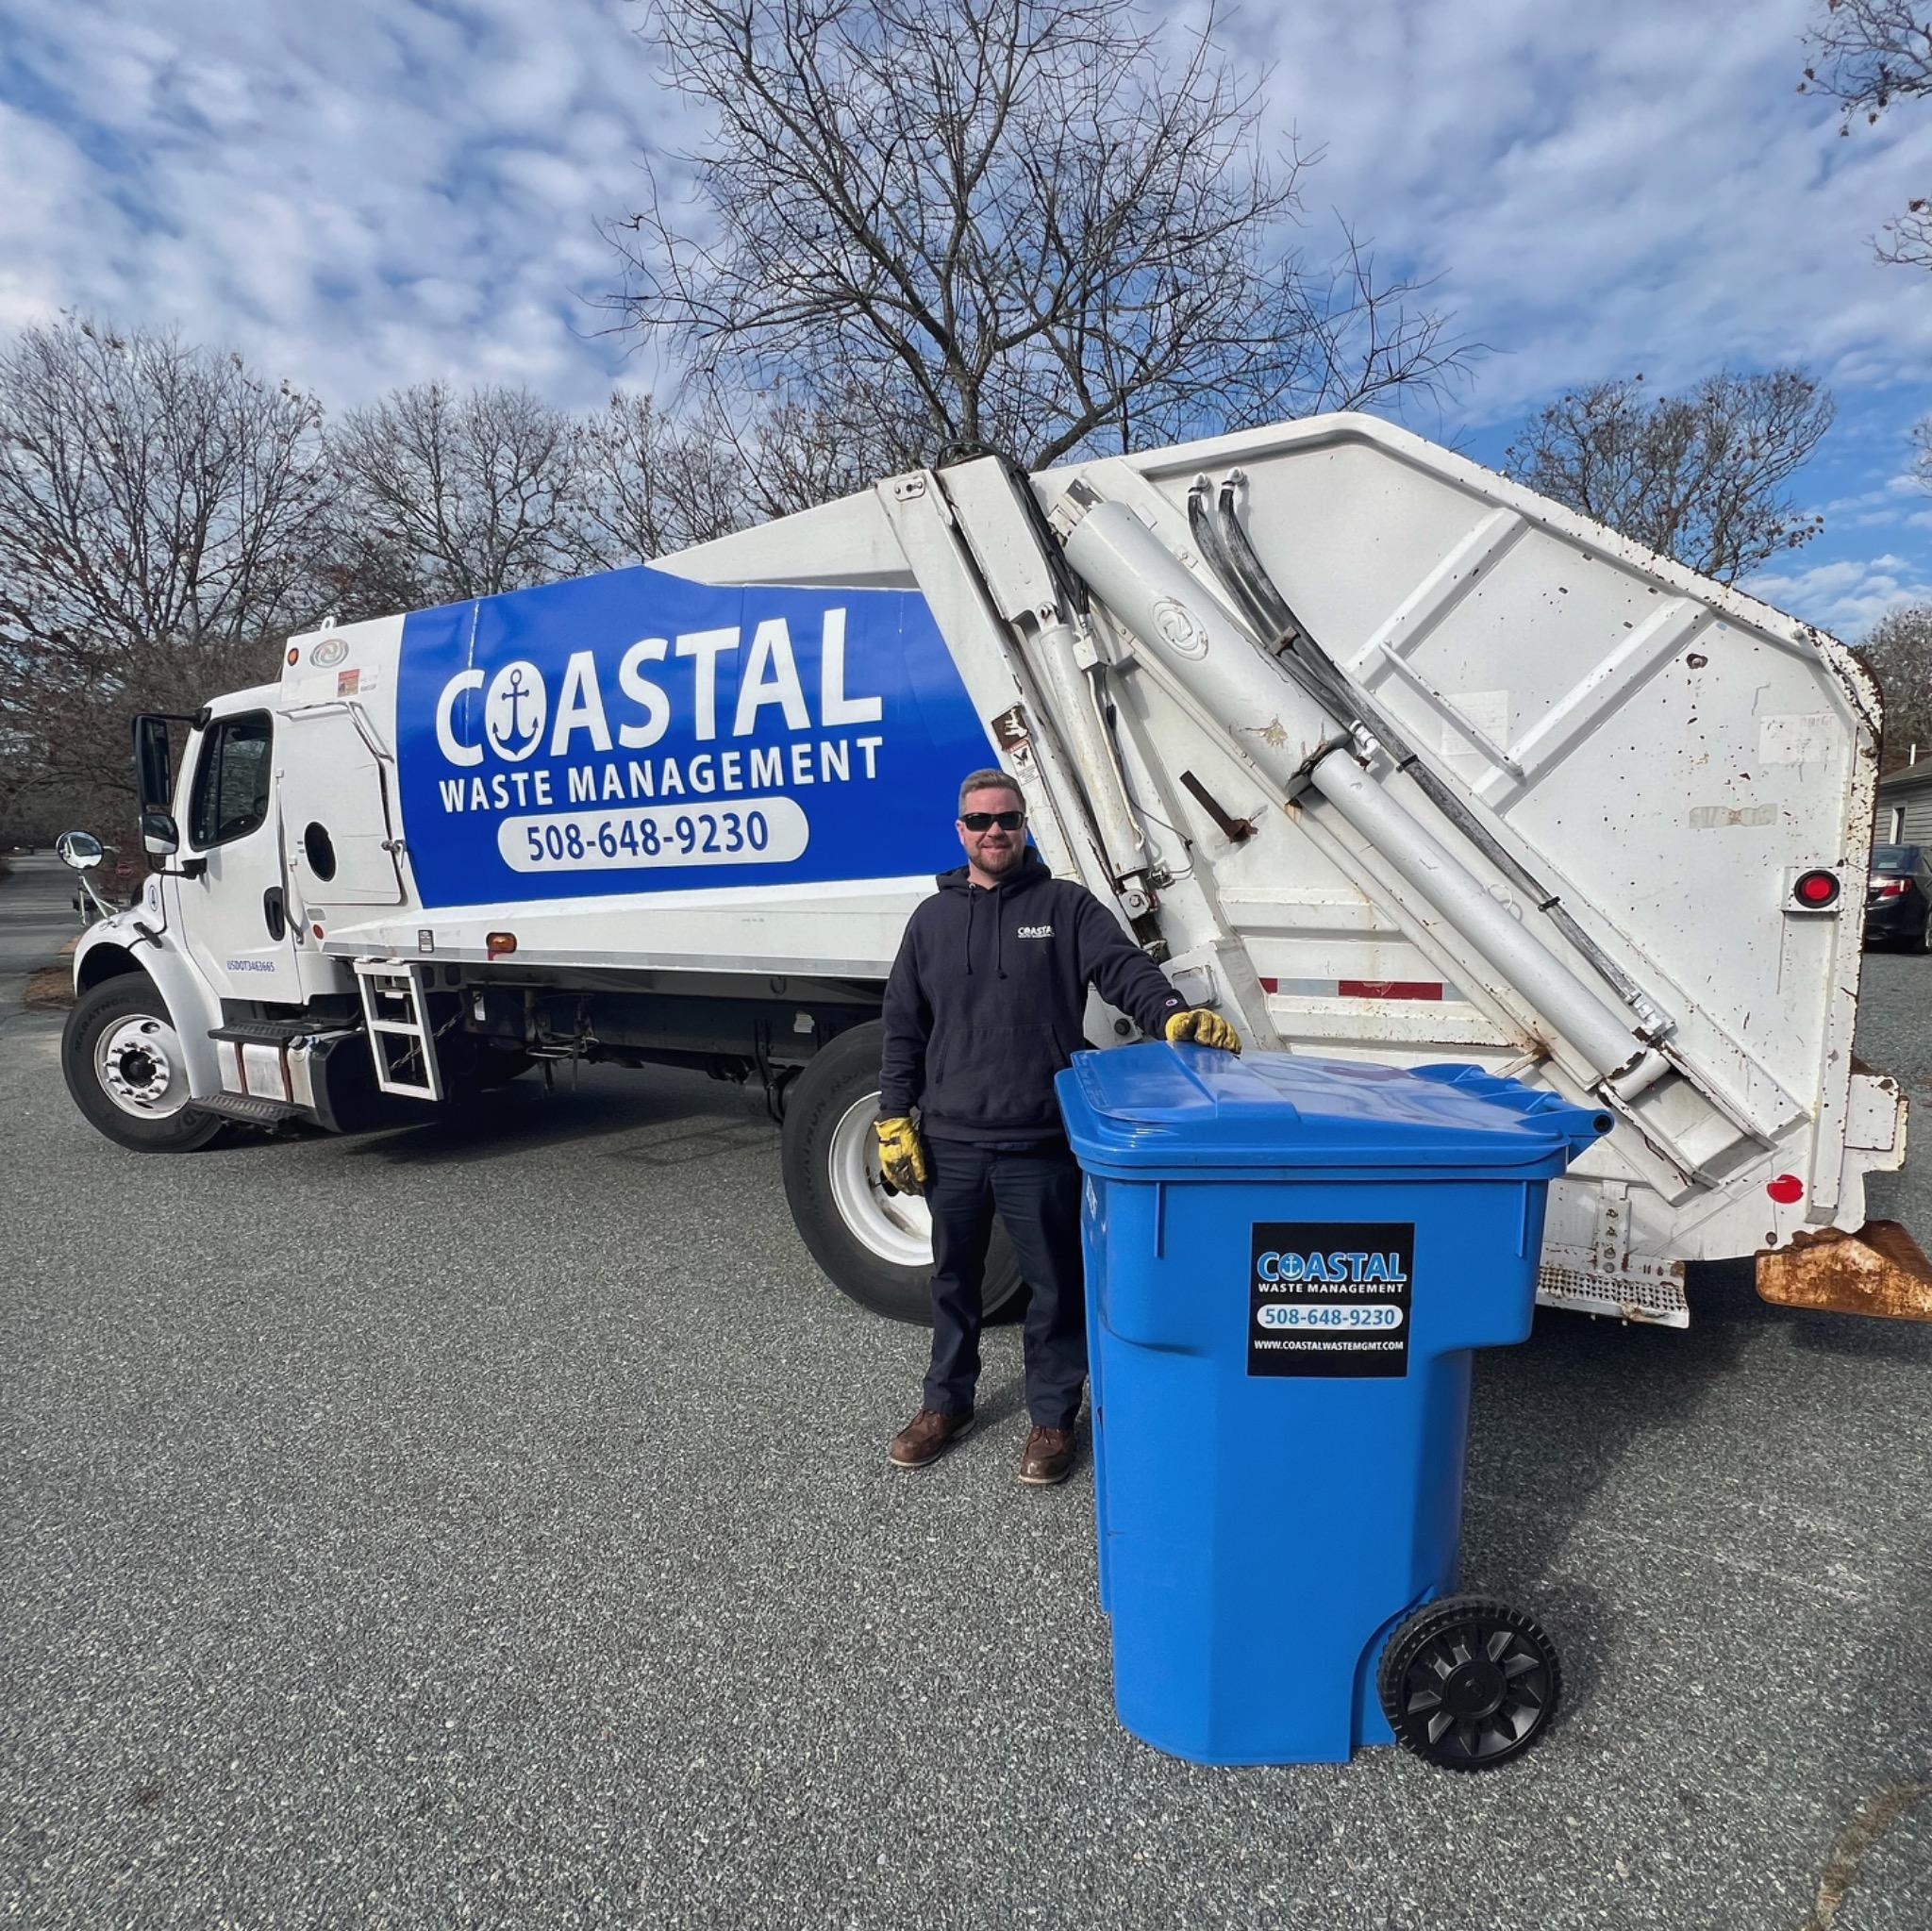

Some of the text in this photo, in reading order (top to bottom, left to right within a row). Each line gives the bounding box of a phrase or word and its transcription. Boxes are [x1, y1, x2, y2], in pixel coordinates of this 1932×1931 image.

[435, 607, 883, 767] COASTAL
[439, 736, 884, 813] WASTE MANAGEMENT
[526, 810, 769, 861] 508-648-9230
[1257, 1251, 1407, 1282] COASTAL
[1257, 1283, 1404, 1294] WASTE MANAGEMENT
[1264, 1308, 1395, 1326] 508-648-9230
[1254, 1340, 1404, 1352] WWW.COASTALWASTEMGMT.COM
